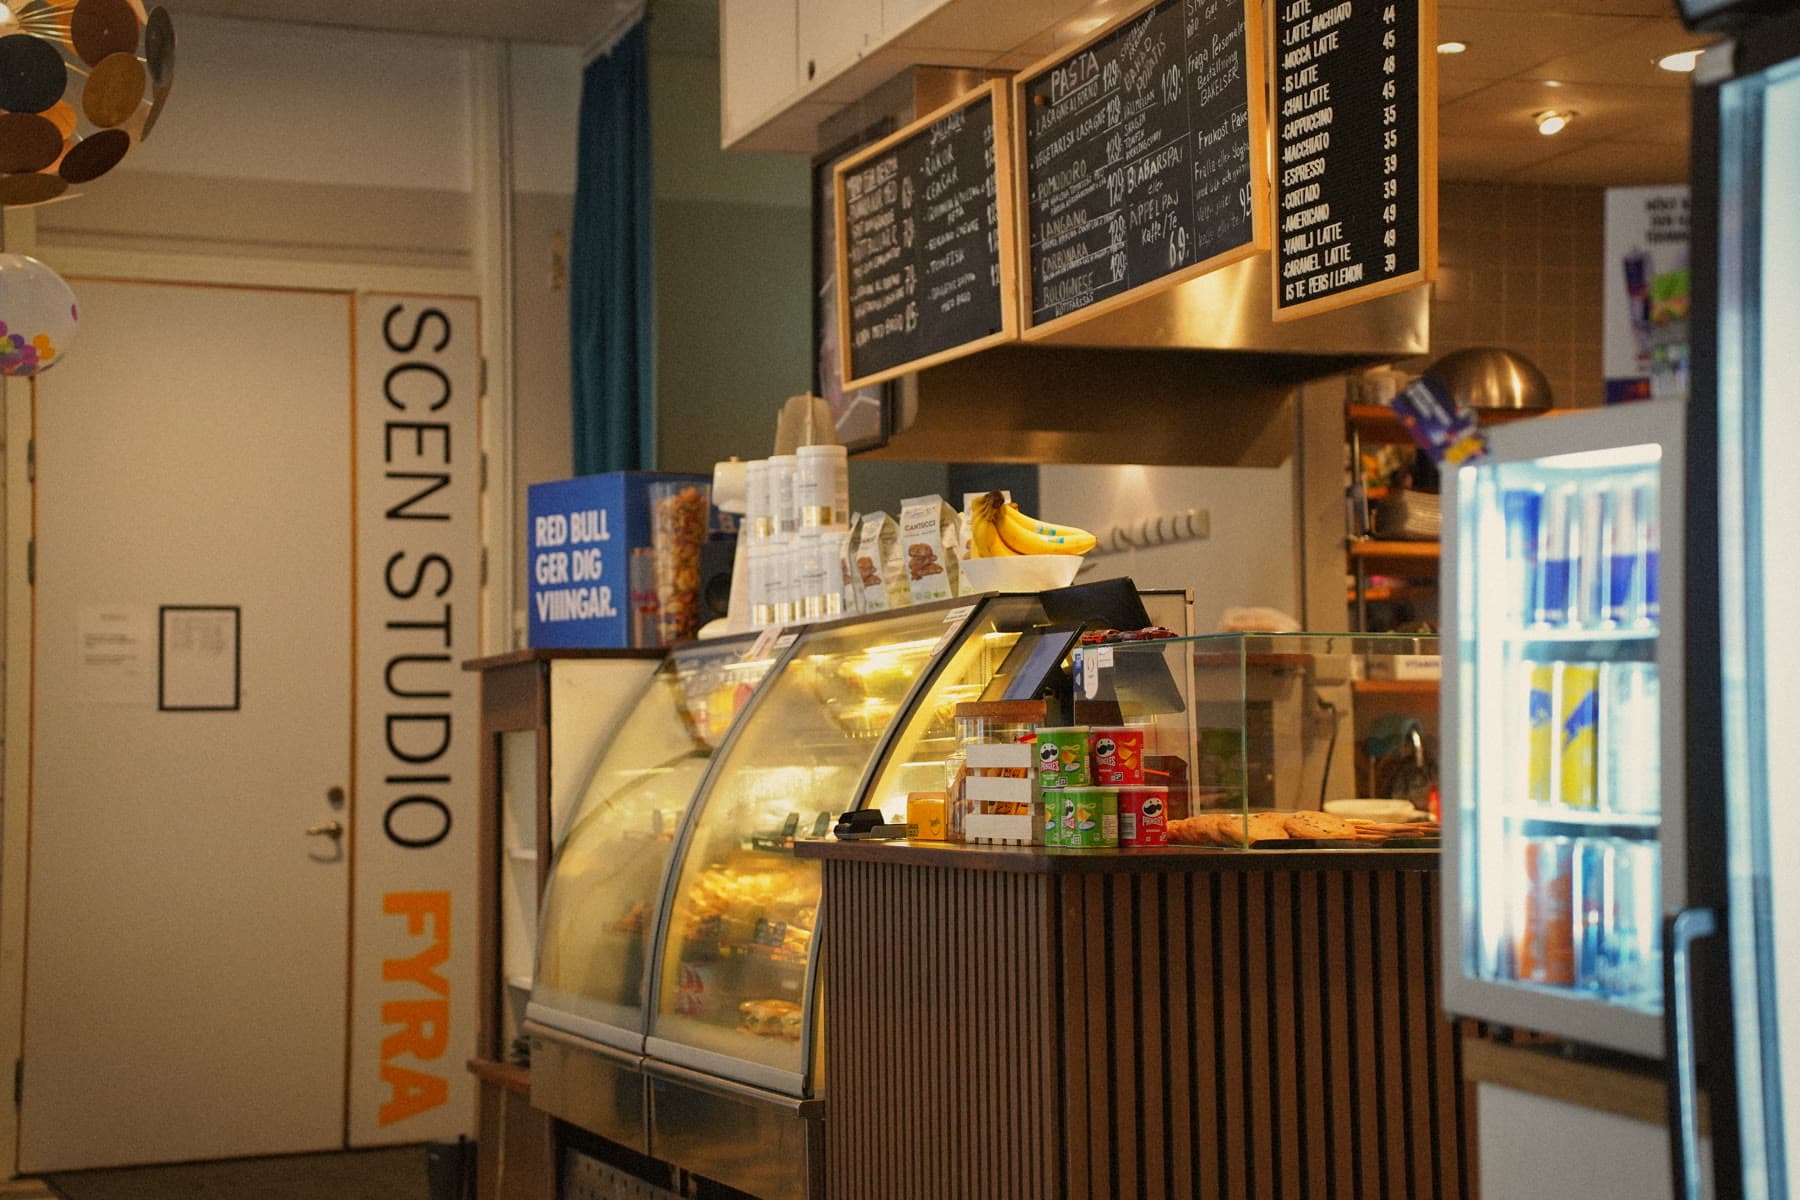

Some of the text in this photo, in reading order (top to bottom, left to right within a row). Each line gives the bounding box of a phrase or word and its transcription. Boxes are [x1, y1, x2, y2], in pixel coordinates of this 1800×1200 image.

[1286, 20, 1311, 46] LATTE
[1313, 31, 1339, 57] LATTE
[1383, 4, 1396, 24] 44
[1051, 51, 1100, 103] PASTA
[1294, 64, 1319, 90] LATTE
[1382, 29, 1396, 50] 45
[1304, 83, 1330, 109] LATTE
[1382, 55, 1396, 75] 48
[1382, 80, 1396, 100] 45
[1198, 119, 1229, 150] Frukost
[1383, 104, 1397, 126] 35
[1284, 129, 1397, 187] ESPRESSO 35
[1284, 154, 1397, 210] CORTADO 39
[1383, 179, 1397, 199] 39
[1317, 222, 1343, 246] LATTE
[1383, 203, 1397, 223] 49
[1284, 228, 1397, 279] CARAMEL LATTE 49
[1384, 253, 1397, 273] 39
[535, 508, 611, 548] RED BULL
[535, 547, 603, 585] GER DIG
[378, 304, 453, 1128] SCEN STUDIO FYRA
